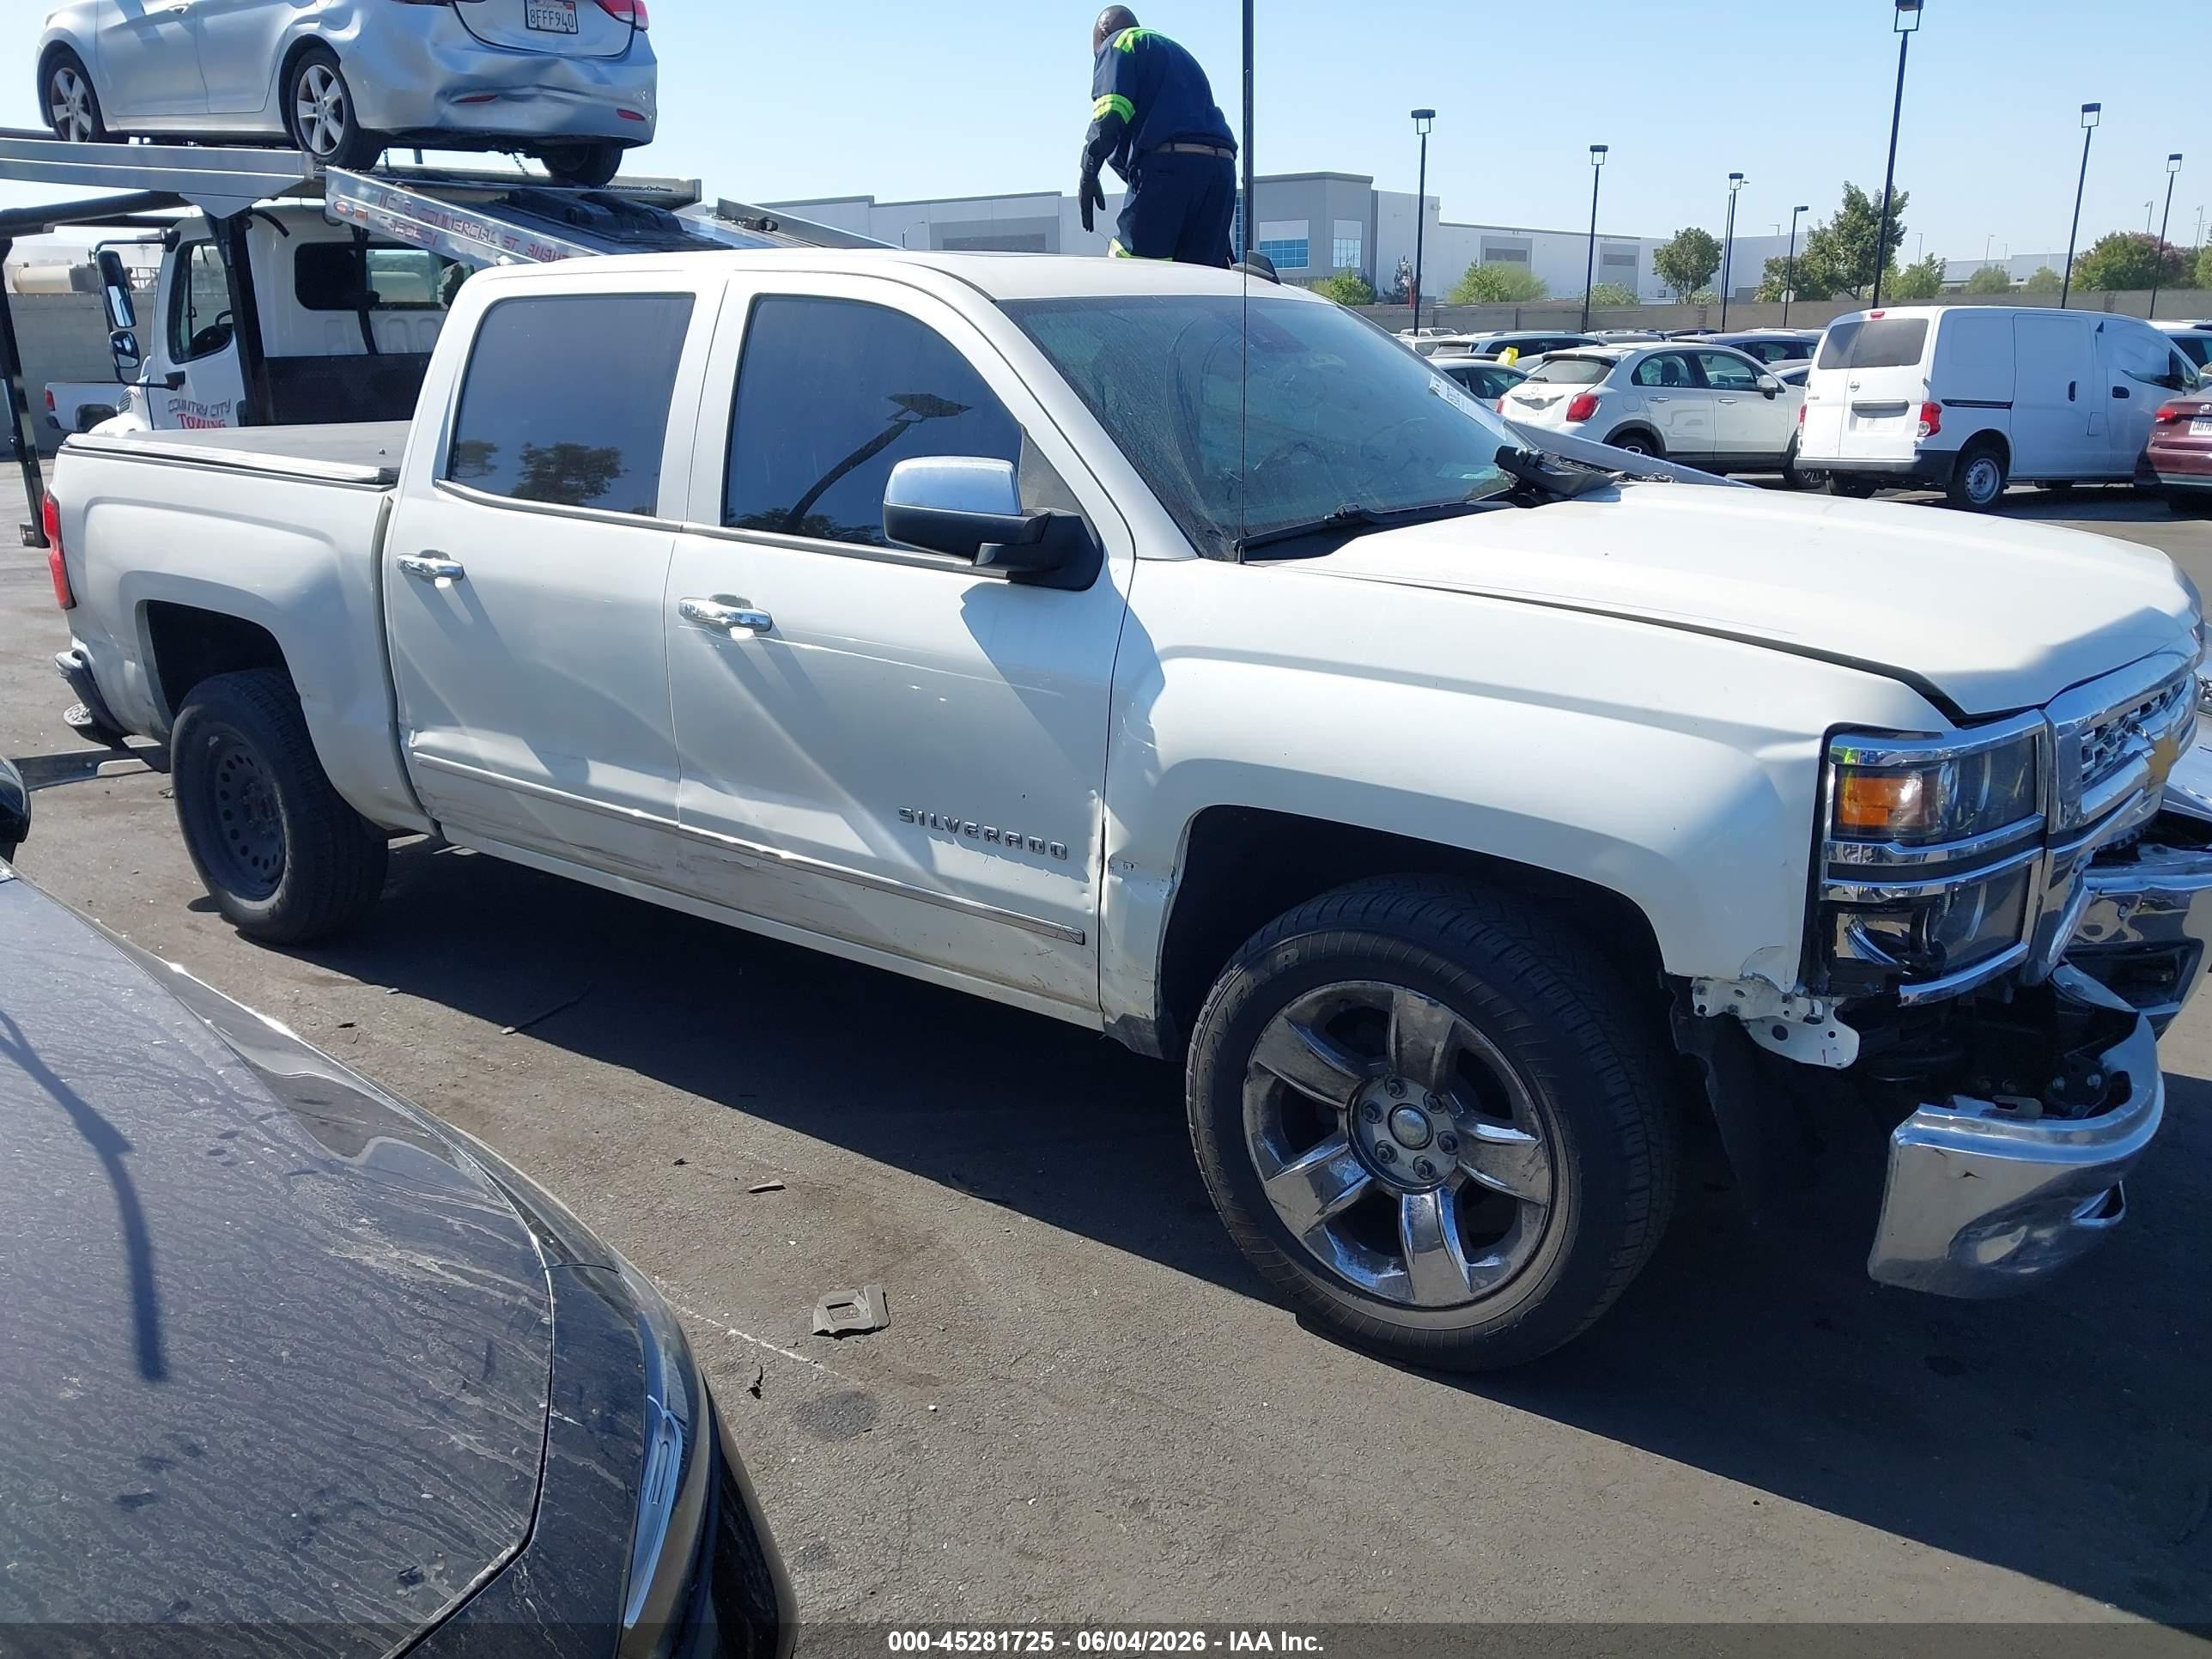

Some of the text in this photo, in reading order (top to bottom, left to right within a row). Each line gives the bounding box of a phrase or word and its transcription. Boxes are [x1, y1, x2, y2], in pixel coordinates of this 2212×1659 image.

[530, 9, 574, 27] 8FFF940
[210, 398, 231, 416] CITY
[177, 413, 227, 429] TOWING
[898, 806, 1067, 860] SILVERADO
